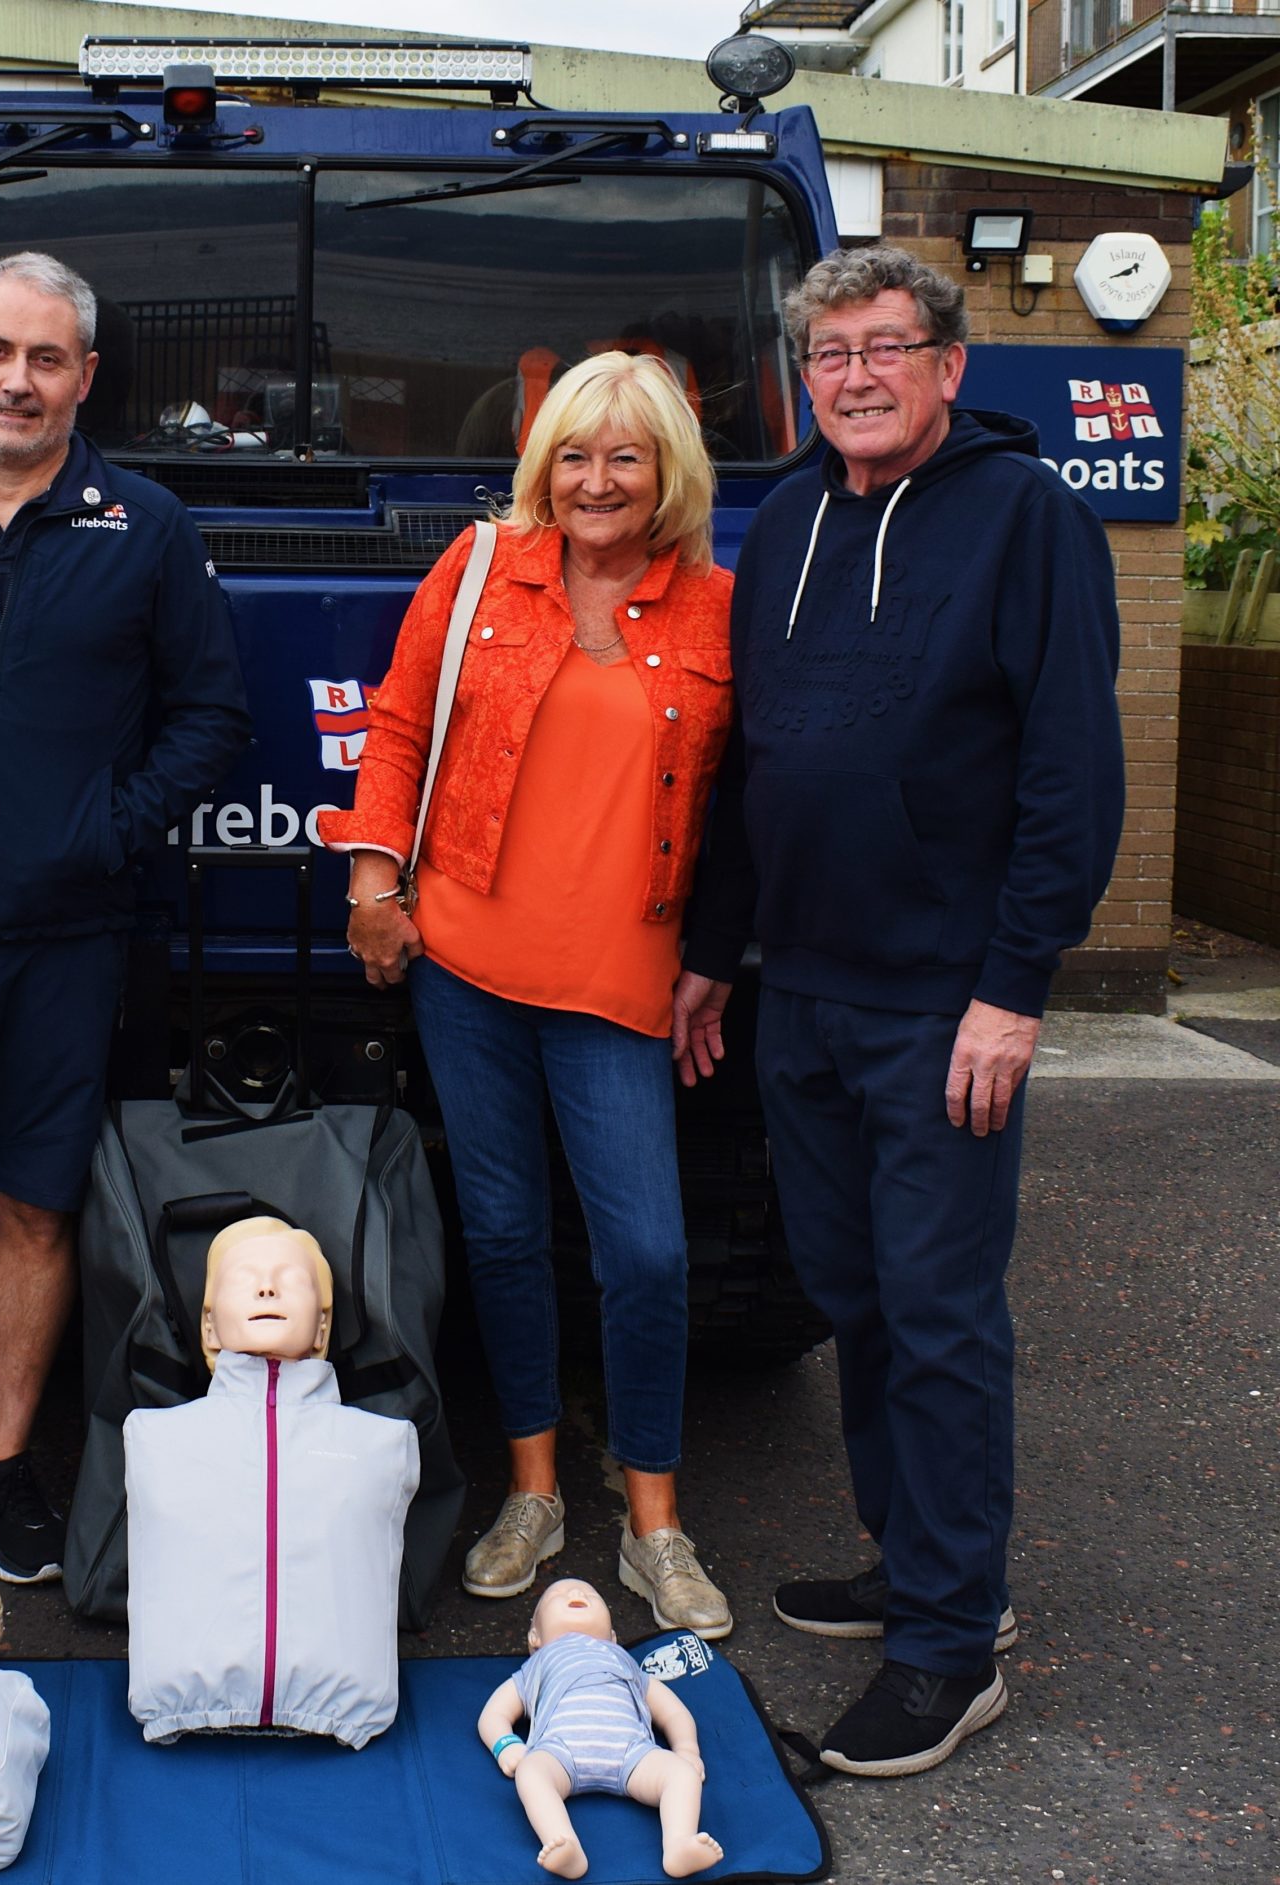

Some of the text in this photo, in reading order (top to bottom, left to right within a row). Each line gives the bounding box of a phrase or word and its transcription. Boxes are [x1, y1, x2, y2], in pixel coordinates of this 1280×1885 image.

[1110, 248, 1146, 262] Island
[1099, 280, 1123, 301] 07976
[1039, 451, 1165, 491] oats
[71, 517, 129, 531] Lifeboats
[326, 685, 349, 708] R
[677, 1634, 707, 1677] Laerdal
